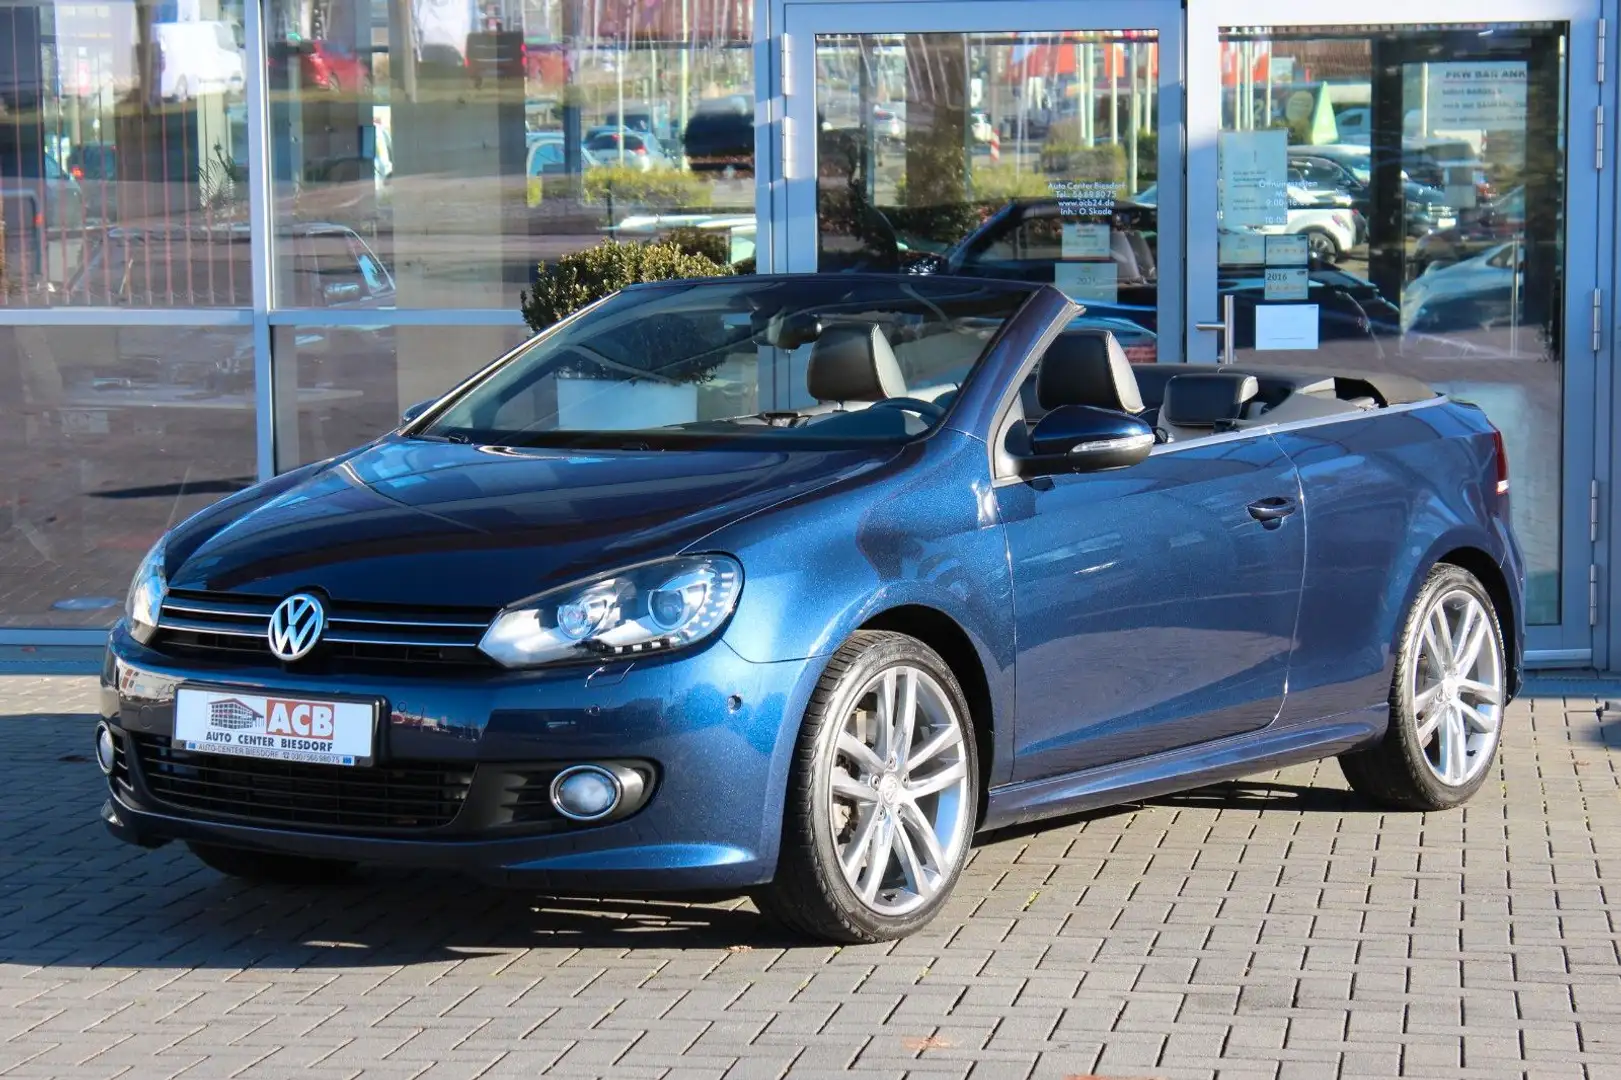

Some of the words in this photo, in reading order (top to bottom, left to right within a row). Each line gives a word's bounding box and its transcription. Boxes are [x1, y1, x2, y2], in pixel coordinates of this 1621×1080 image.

[1048, 182, 1066, 190] Auto
[1067, 182, 1092, 190] Center
[1266, 272, 1288, 282] 2016
[267, 702, 334, 738] ACB
[206, 731, 232, 744] AUTO
[238, 734, 275, 748] CENTER
[281, 738, 334, 753] BIESDORF
